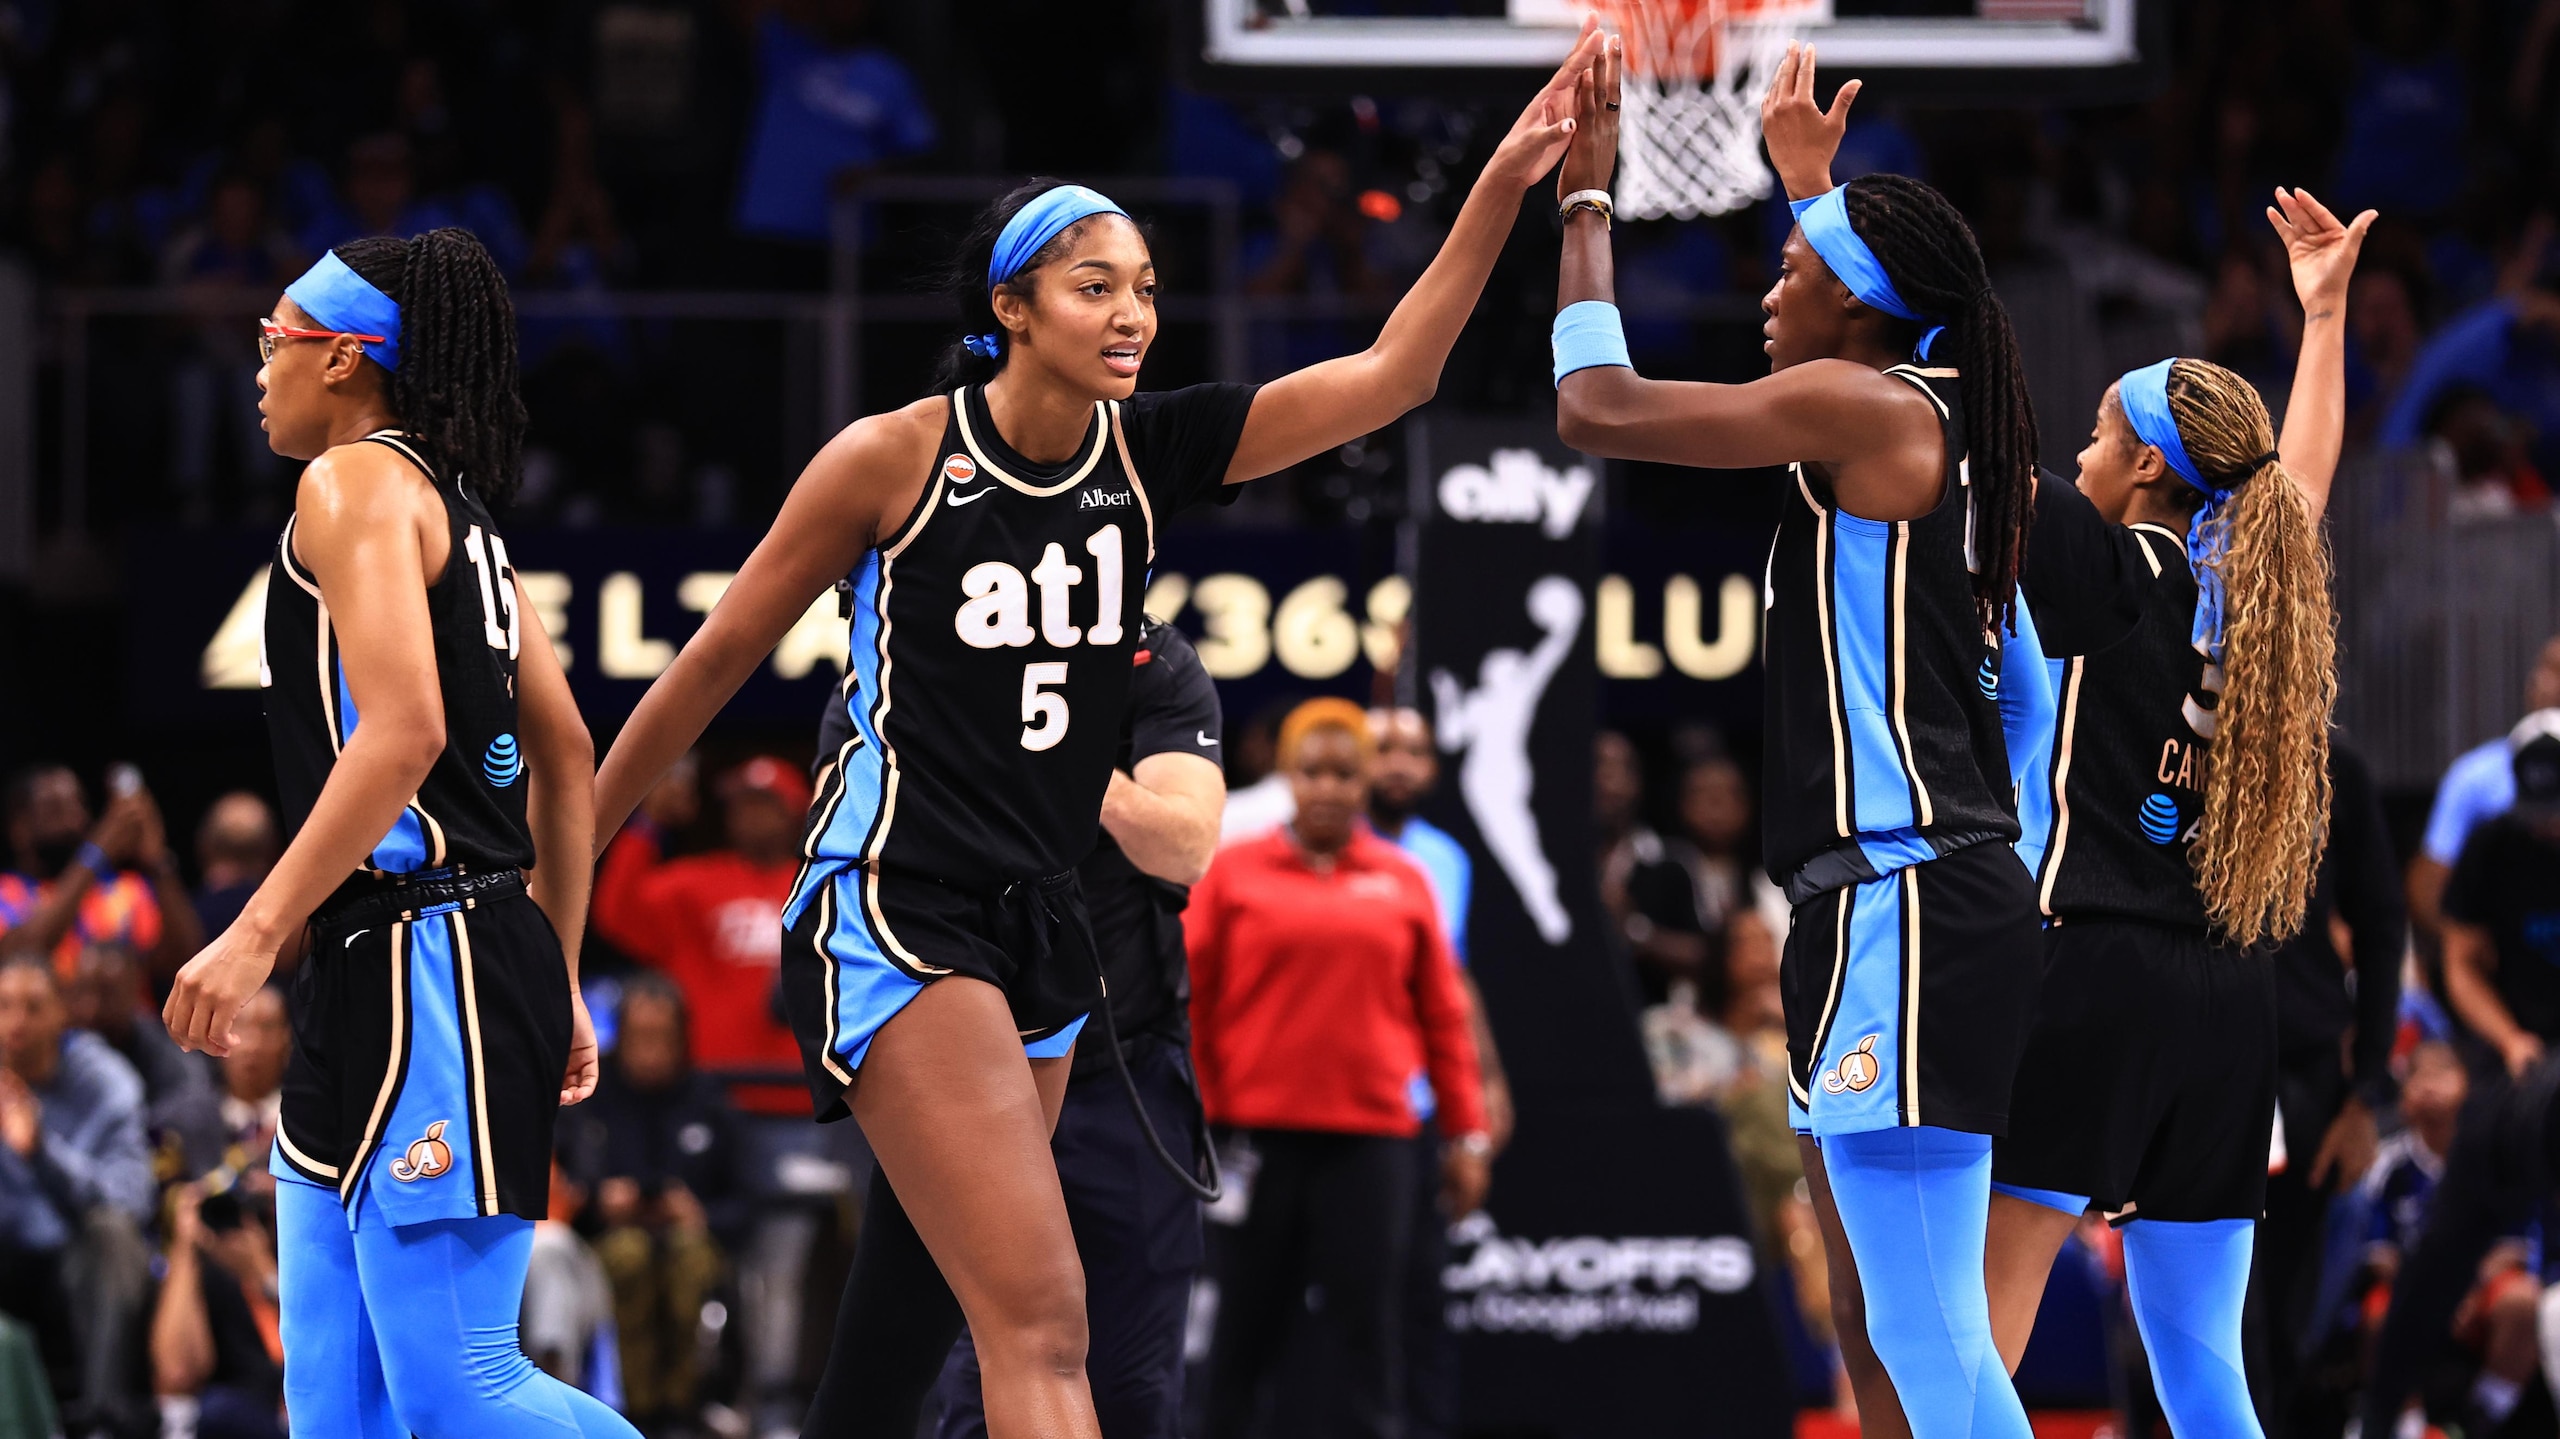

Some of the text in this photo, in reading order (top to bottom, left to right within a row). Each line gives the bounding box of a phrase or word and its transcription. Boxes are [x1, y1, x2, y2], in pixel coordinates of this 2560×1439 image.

[1079, 488, 1131, 509] Albert
[1438, 449, 1594, 539] ally
[463, 524, 520, 660] 15
[1020, 662, 1069, 751] 5
[2158, 738, 2207, 792] CAN
[1442, 1237, 1754, 1292] AYOFFS
